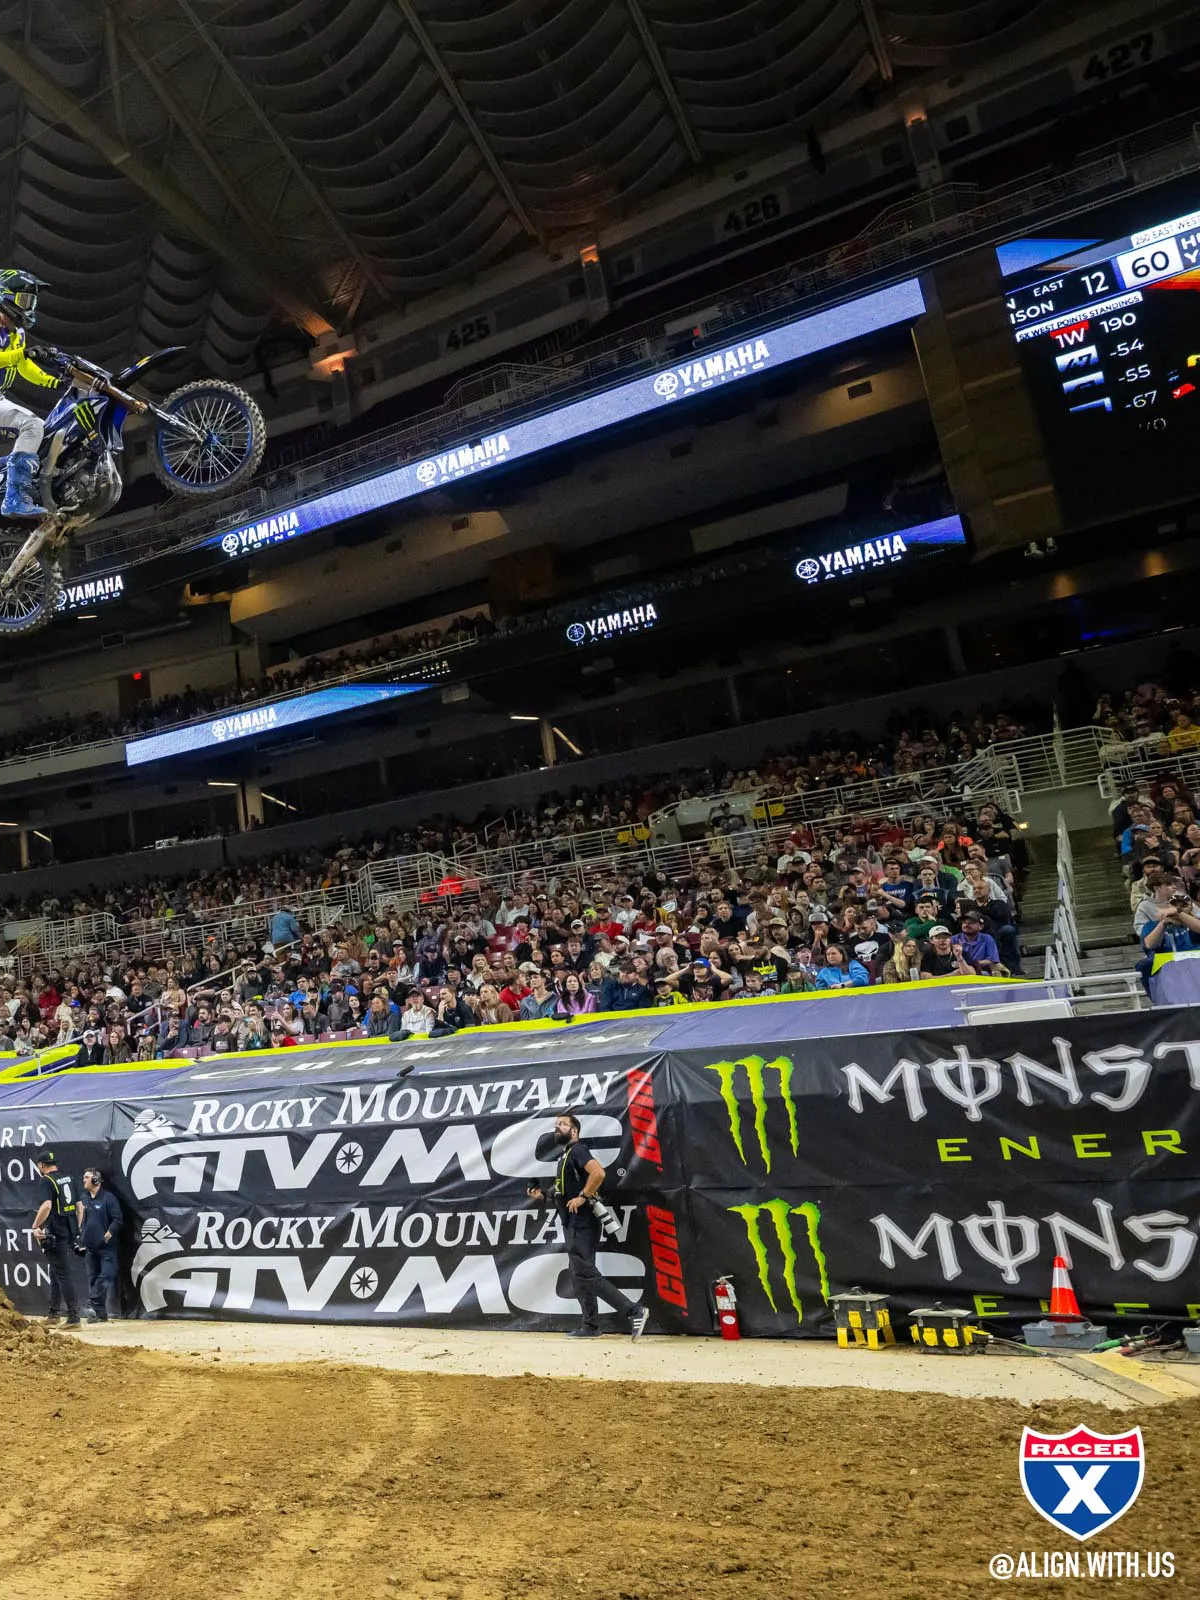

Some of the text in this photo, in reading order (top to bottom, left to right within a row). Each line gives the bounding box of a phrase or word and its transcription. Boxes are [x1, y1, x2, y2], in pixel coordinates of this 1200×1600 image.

[1084, 31, 1154, 80] 427
[1152, 224, 1174, 239] EAST
[1131, 250, 1170, 278] 60
[1033, 271, 1109, 297] EAST 12
[447, 316, 491, 349] 425
[1030, 322, 1056, 337] WEST
[1056, 312, 1088, 329] POINTS
[1088, 295, 1140, 318] STANDINGS
[1055, 312, 1137, 349] 1W 190
[678, 339, 770, 387] YAMAHA
[1109, 338, 1145, 357] -54
[665, 361, 765, 400] RACING
[1118, 364, 1152, 382] -55
[1124, 390, 1158, 409] -67
[436, 434, 511, 475] YAMAHA
[229, 529, 296, 558] RACING
[238, 511, 300, 547] YAMAHA
[819, 533, 907, 573] YAMAHA
[807, 555, 902, 585] RACING
[57, 591, 122, 613] RACING
[67, 575, 125, 603] YAMAHA
[585, 603, 658, 636] YAMAHA
[225, 707, 277, 733] YAMAHA
[183, 1069, 620, 1136] ROCKY MOUNTAIN
[190, 1204, 638, 1250] ROCKY MOUNTAN
